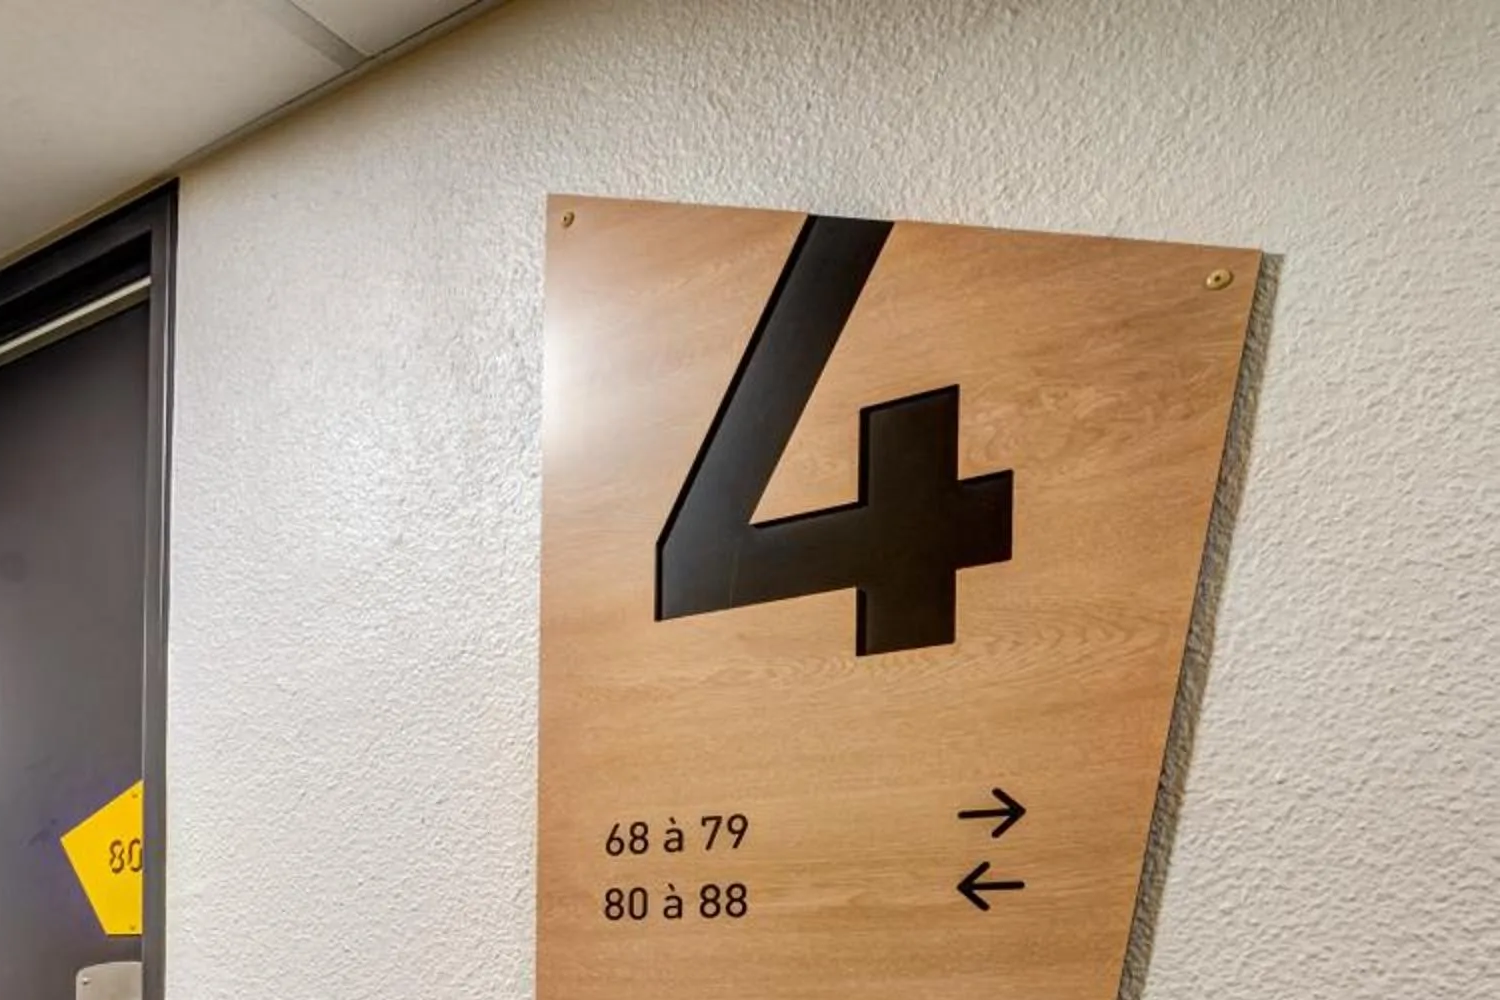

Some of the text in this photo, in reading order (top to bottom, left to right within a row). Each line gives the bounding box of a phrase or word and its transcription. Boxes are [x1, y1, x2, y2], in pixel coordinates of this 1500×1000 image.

[655, 214, 1014, 656] 4
[605, 813, 749, 857] 68 à 79
[109, 838, 143, 874] 80
[605, 882, 748, 921] 80 à 88
